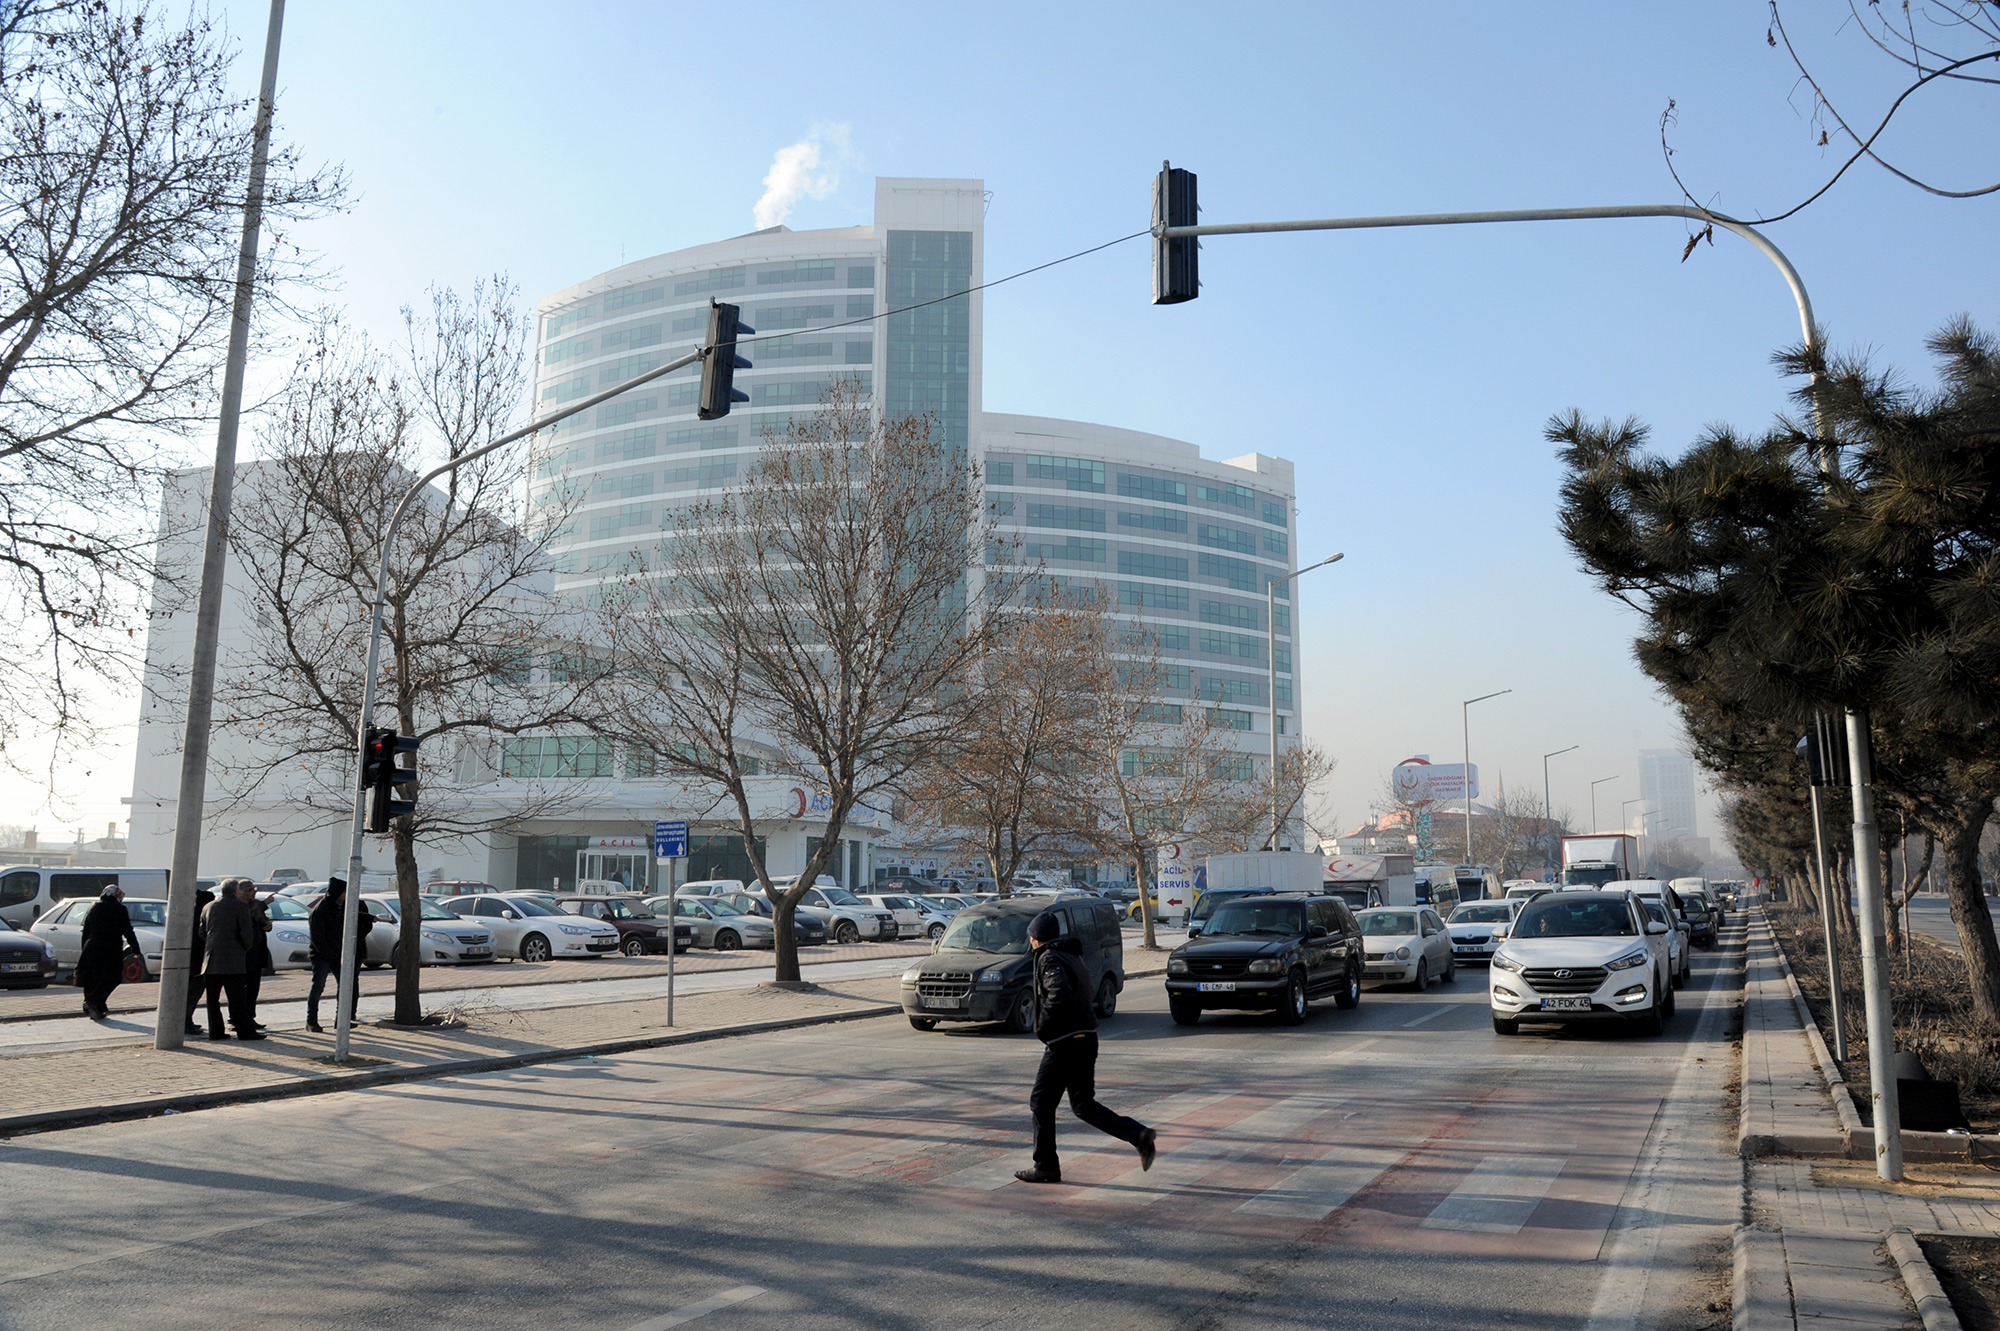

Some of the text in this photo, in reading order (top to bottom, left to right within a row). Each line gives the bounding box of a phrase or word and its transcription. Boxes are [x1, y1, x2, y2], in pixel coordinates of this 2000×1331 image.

[1164, 865, 1183, 875] ACİL
[1160, 879, 1190, 888] SERVİS
[1546, 999, 1590, 1008] 42 FDK 45
